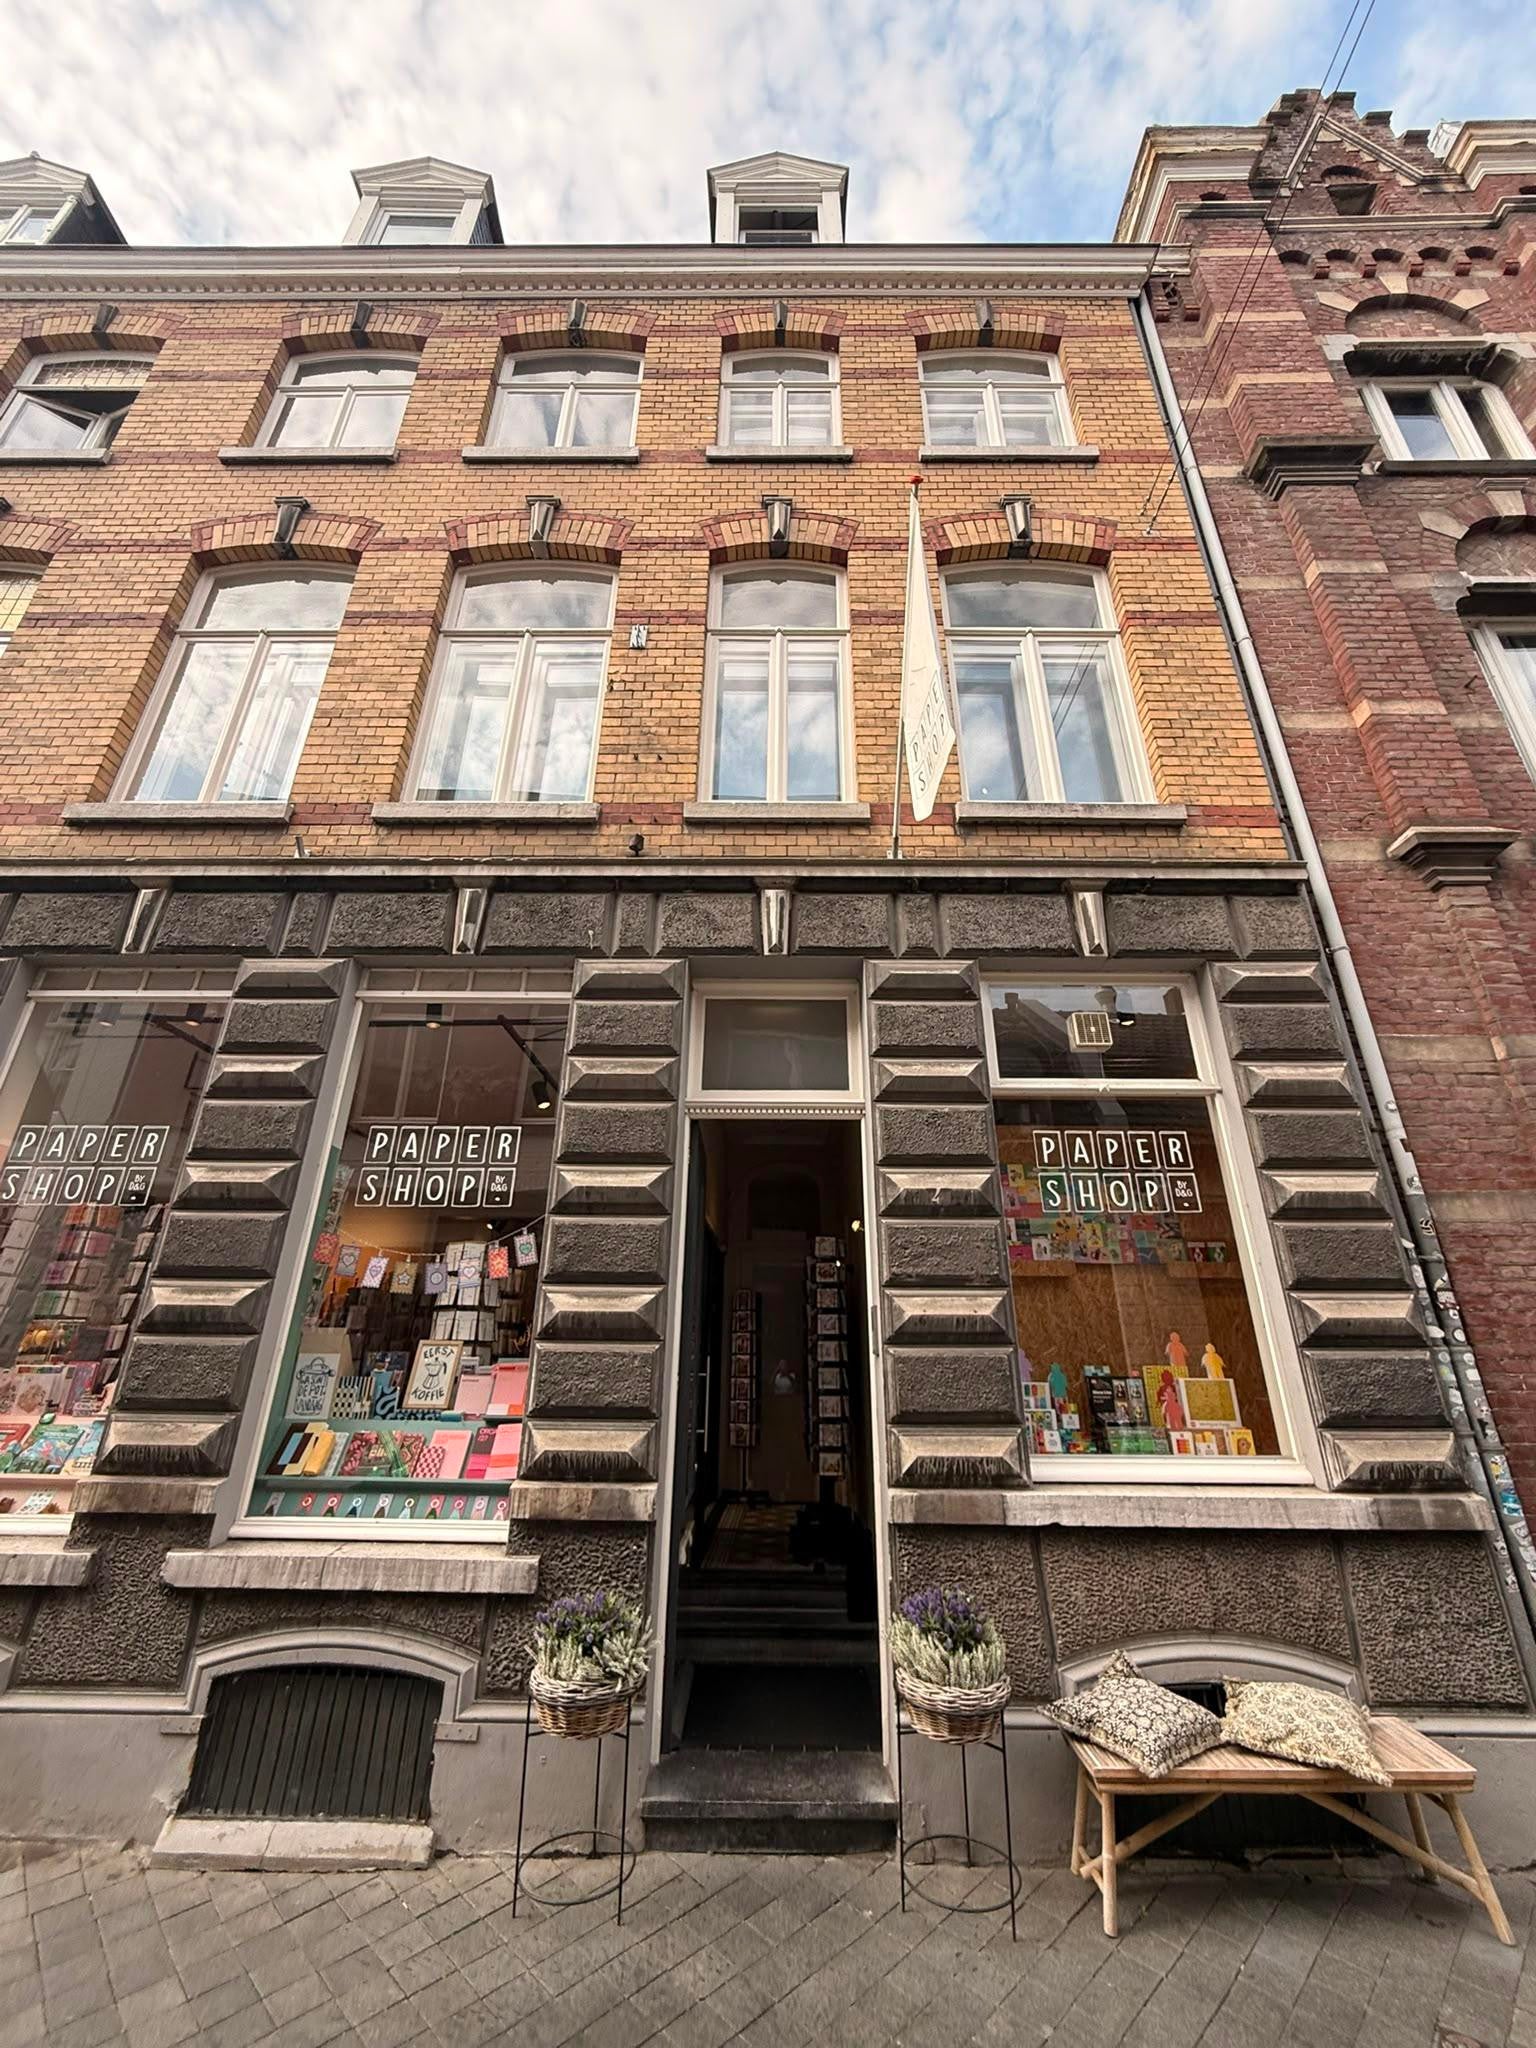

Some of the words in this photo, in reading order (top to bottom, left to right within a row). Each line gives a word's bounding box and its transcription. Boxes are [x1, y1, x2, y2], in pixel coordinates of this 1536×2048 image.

[17, 1131, 159, 1159] PAPER
[372, 1132, 513, 1160] PAPER
[1041, 1136, 1184, 1164] PAPER
[2, 1173, 115, 1201] SHOP
[363, 1174, 476, 1202] SHOP
[495, 1175, 506, 1184] BY
[1046, 1179, 1158, 1207] SHOP
[423, 1346, 455, 1359] EERST
[411, 1387, 445, 1401] KOFFIE
